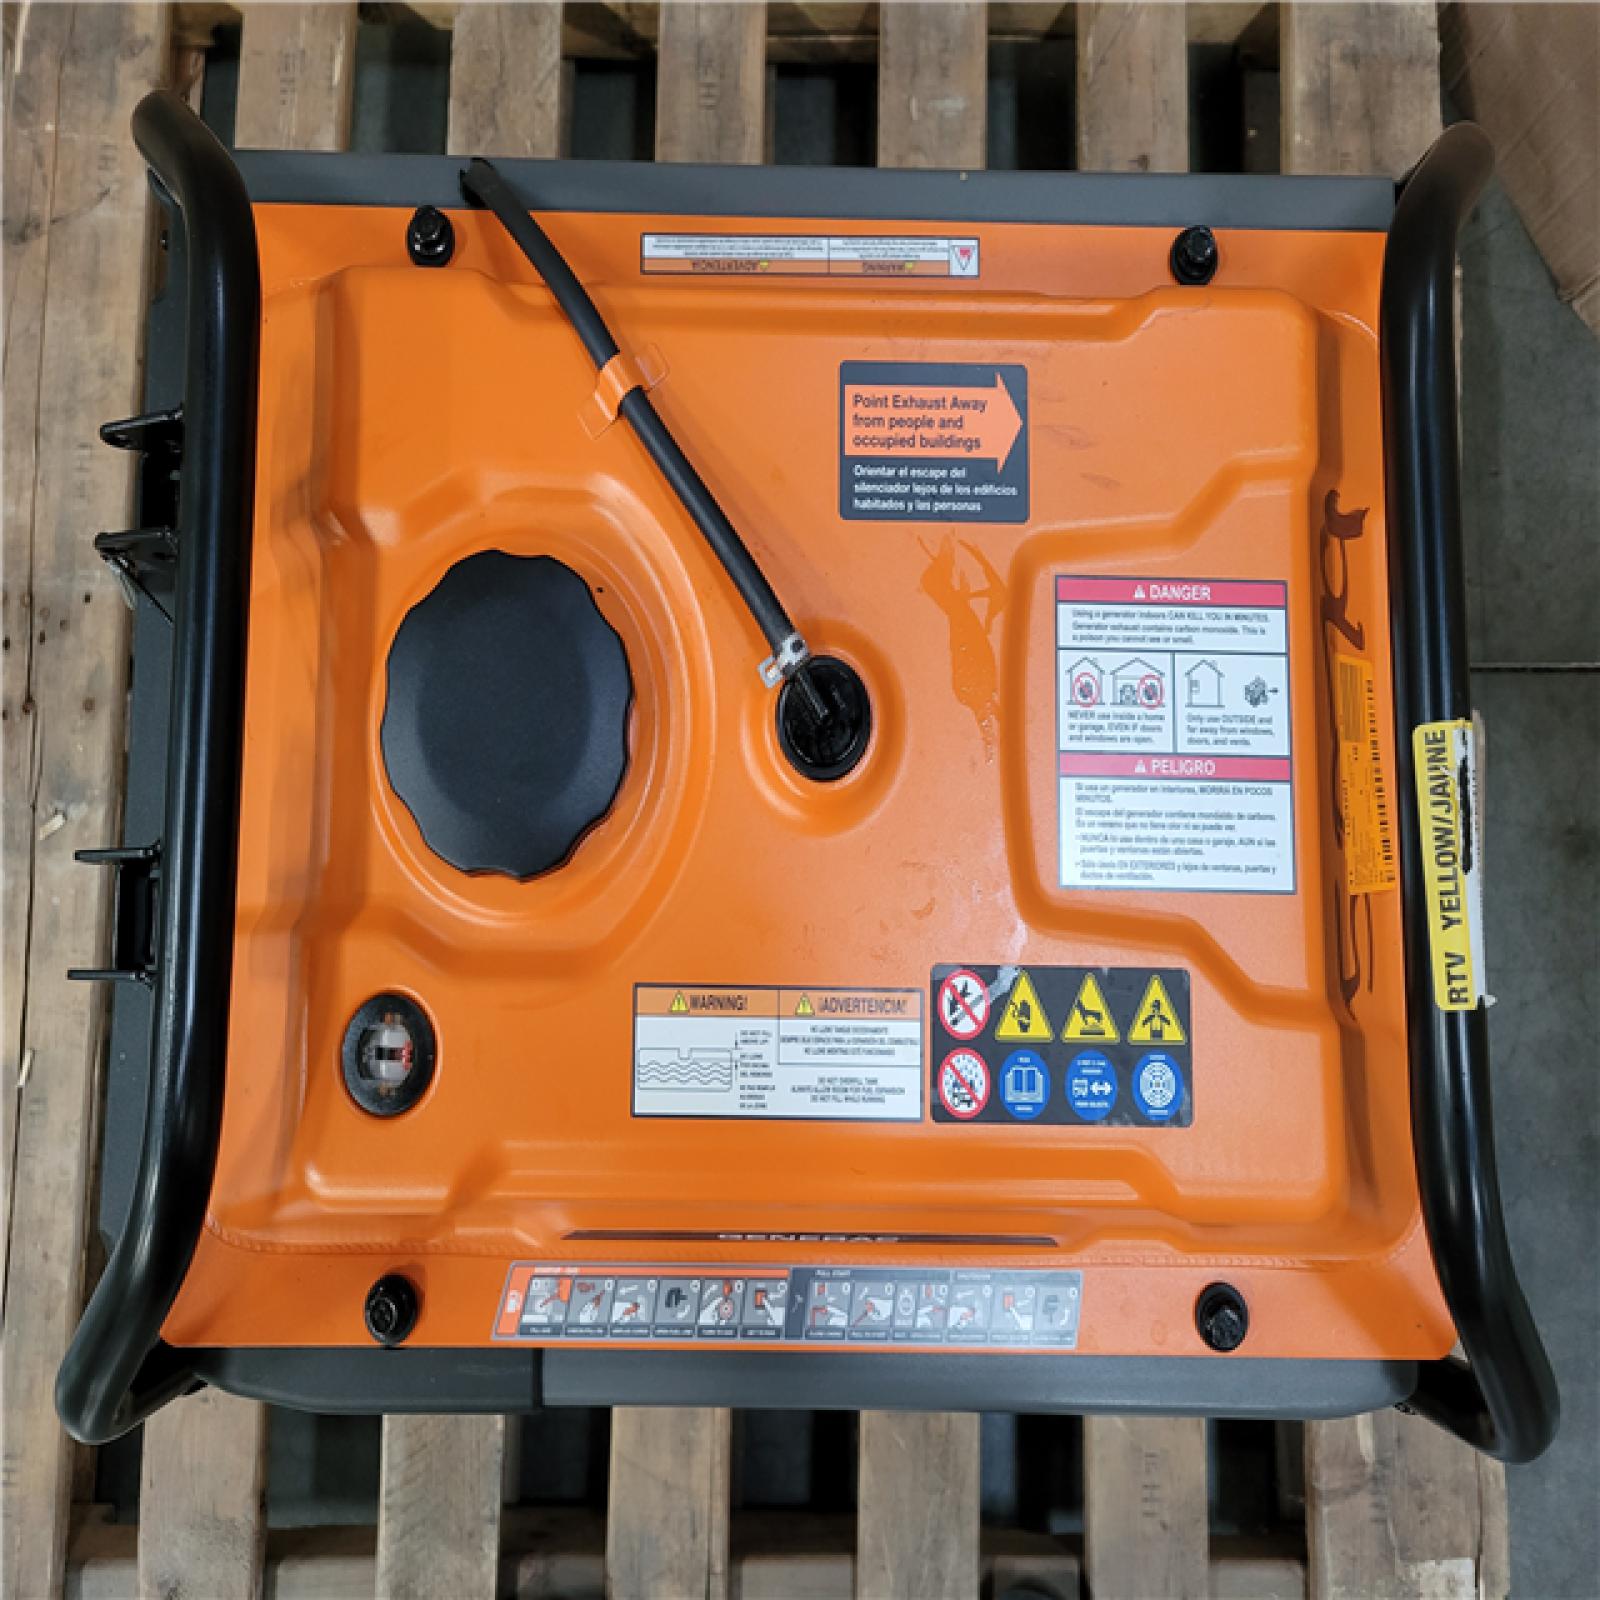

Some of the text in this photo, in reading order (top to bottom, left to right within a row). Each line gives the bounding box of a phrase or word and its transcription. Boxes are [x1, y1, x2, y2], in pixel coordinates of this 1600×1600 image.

[853, 394, 987, 412] Point Exhaust Away
[853, 415, 963, 430] from people and
[853, 435, 980, 452] occupied buildings
[854, 465, 965, 480] Orientar el escape del
[855, 483, 1017, 495] silenciador lejos de los edificios
[854, 499, 981, 513] habitados y las personas
[1150, 585, 1210, 600] DANGER
[1152, 760, 1216, 775] PELIGRO
[1445, 952, 1470, 1005] RTV
[690, 994, 748, 1010] WARNING!
[818, 998, 908, 1013] ¡ADVERTENCIA!
